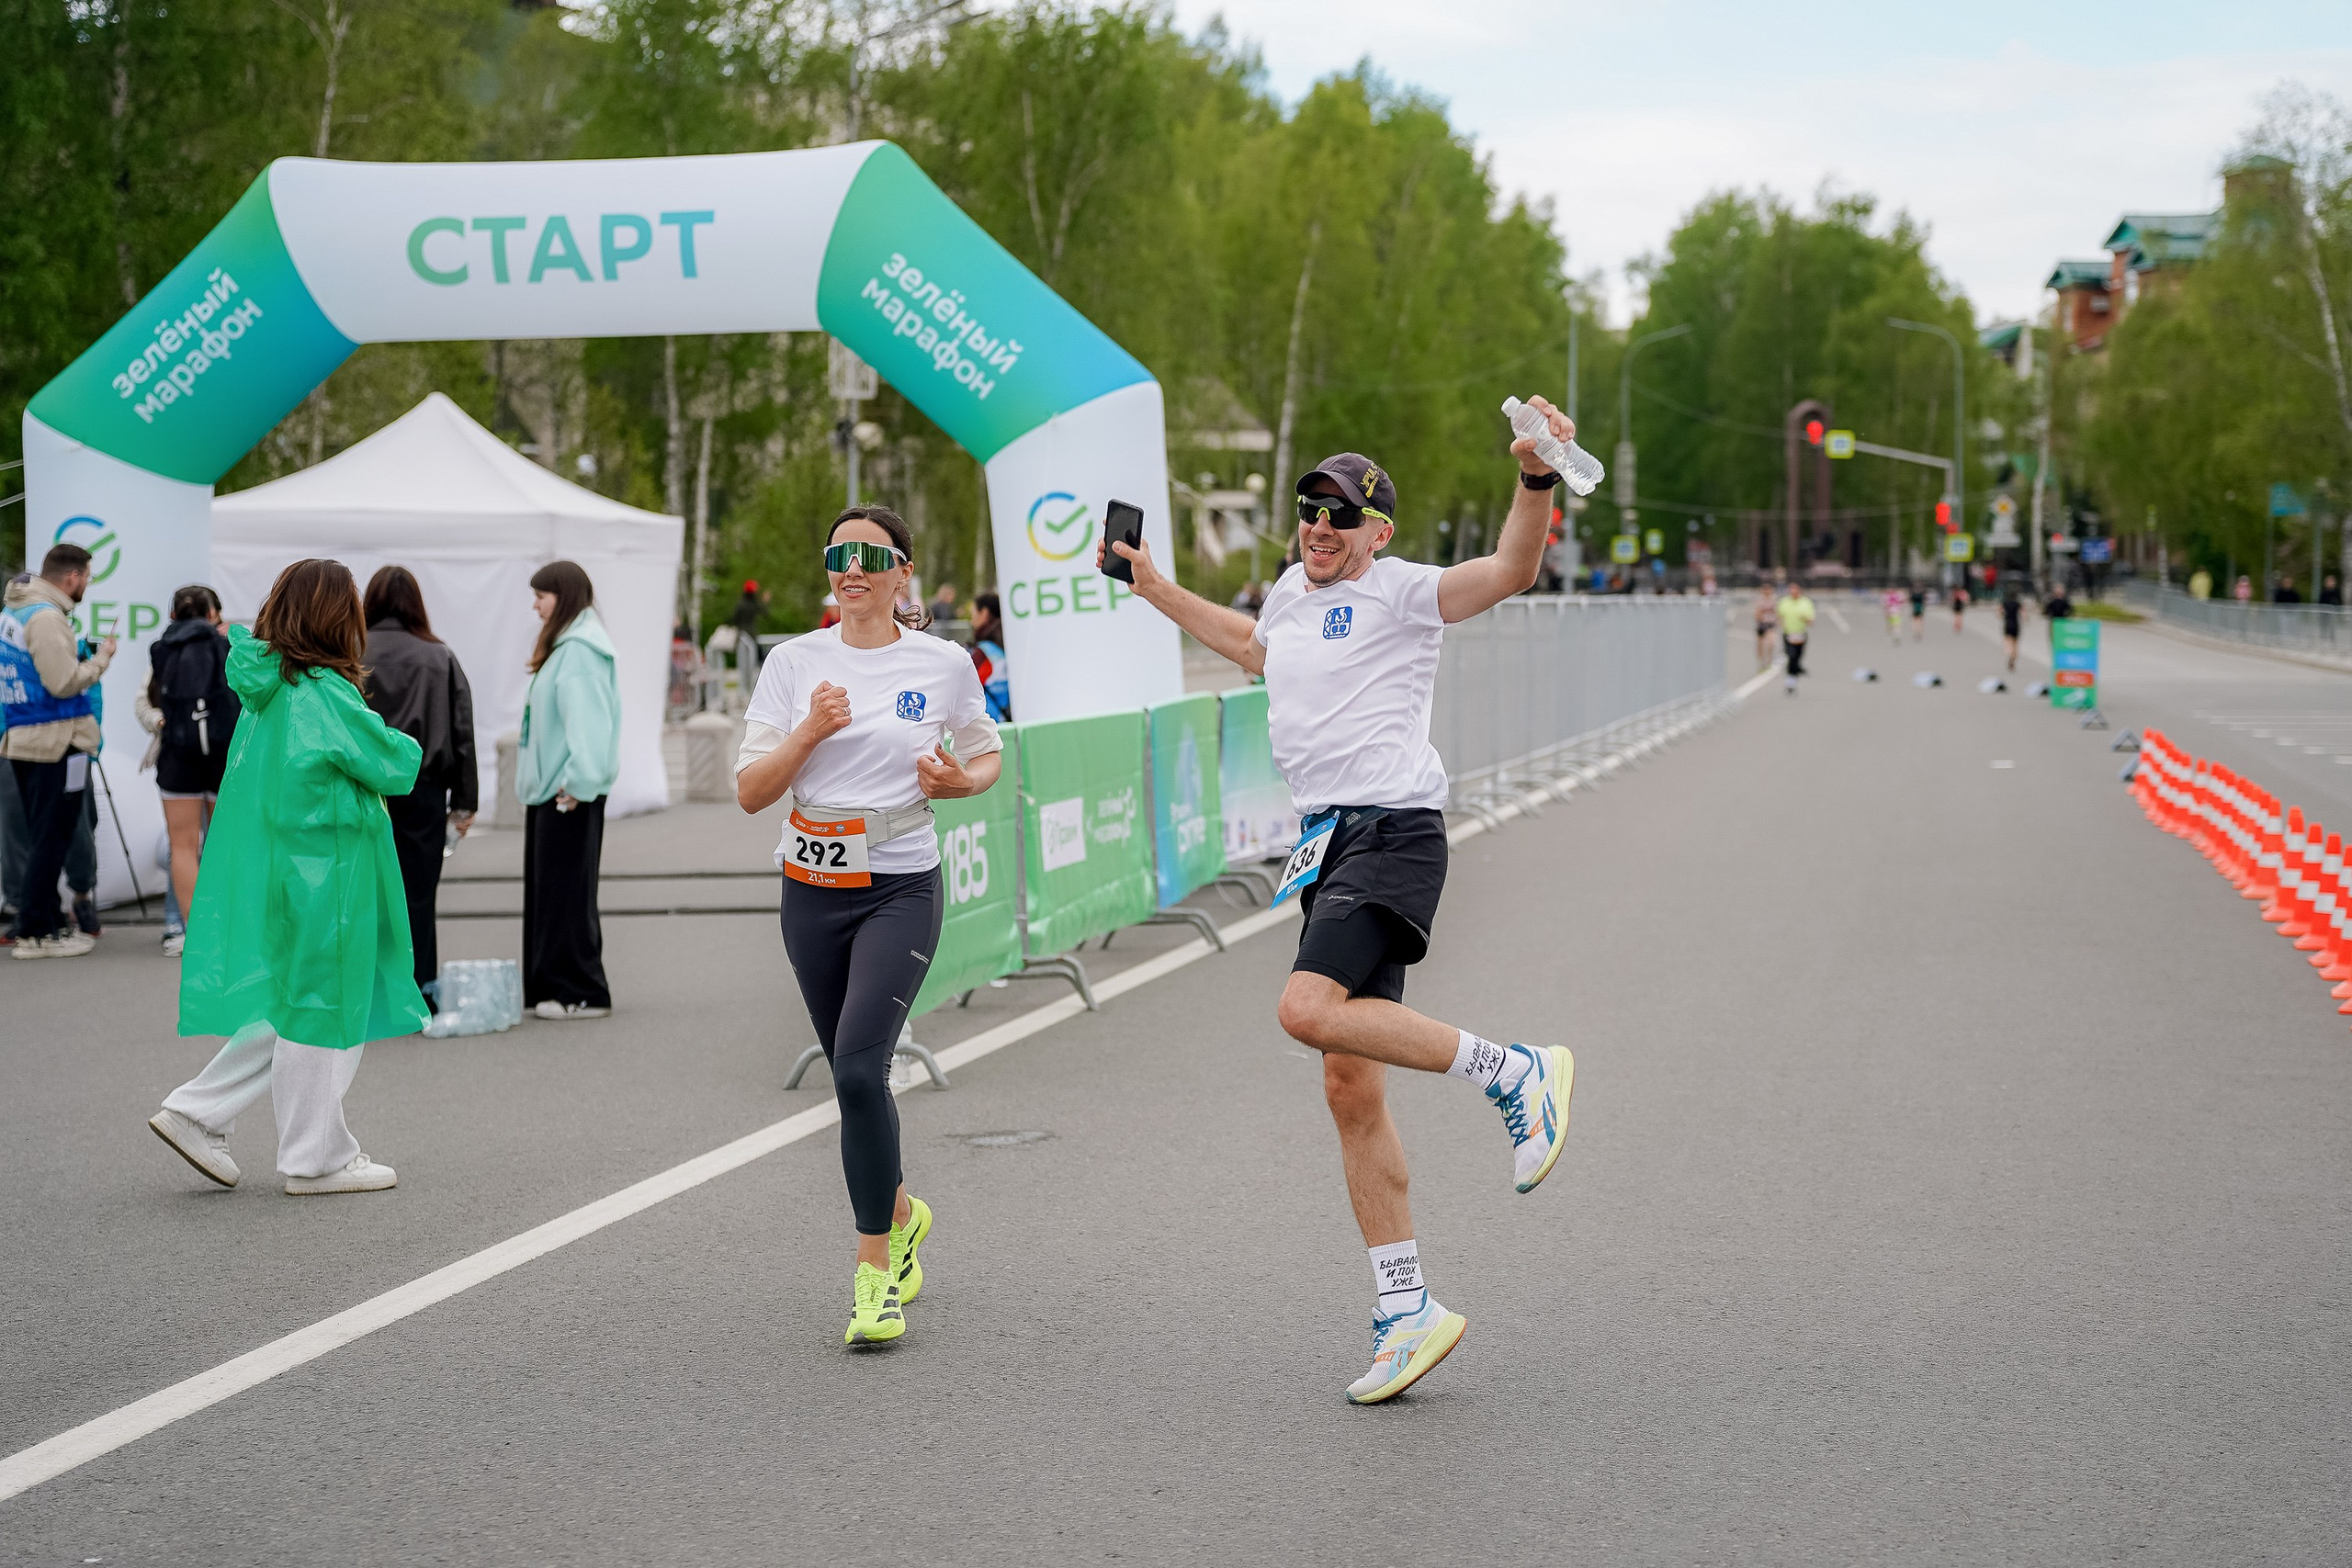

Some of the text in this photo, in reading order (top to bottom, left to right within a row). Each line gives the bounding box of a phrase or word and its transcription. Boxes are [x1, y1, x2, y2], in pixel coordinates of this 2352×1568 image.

[407, 210, 715, 287] СТАРТ
[112, 266, 240, 399] зелёный
[881, 252, 1023, 375] зелёный
[861, 277, 995, 400] марафон
[133, 298, 264, 424] марафон
[796, 836, 848, 866] 292
[944, 820, 989, 906] 185
[1286, 840, 1318, 881] 636
[1476, 1062, 1485, 1074] И
[1487, 1047, 1500, 1073] УЖЕ
[1379, 1255, 1419, 1269] БЫВАЛО
[1386, 1266, 1416, 1278] И ПОХ
[1391, 1277, 1414, 1287] УЖЕ
